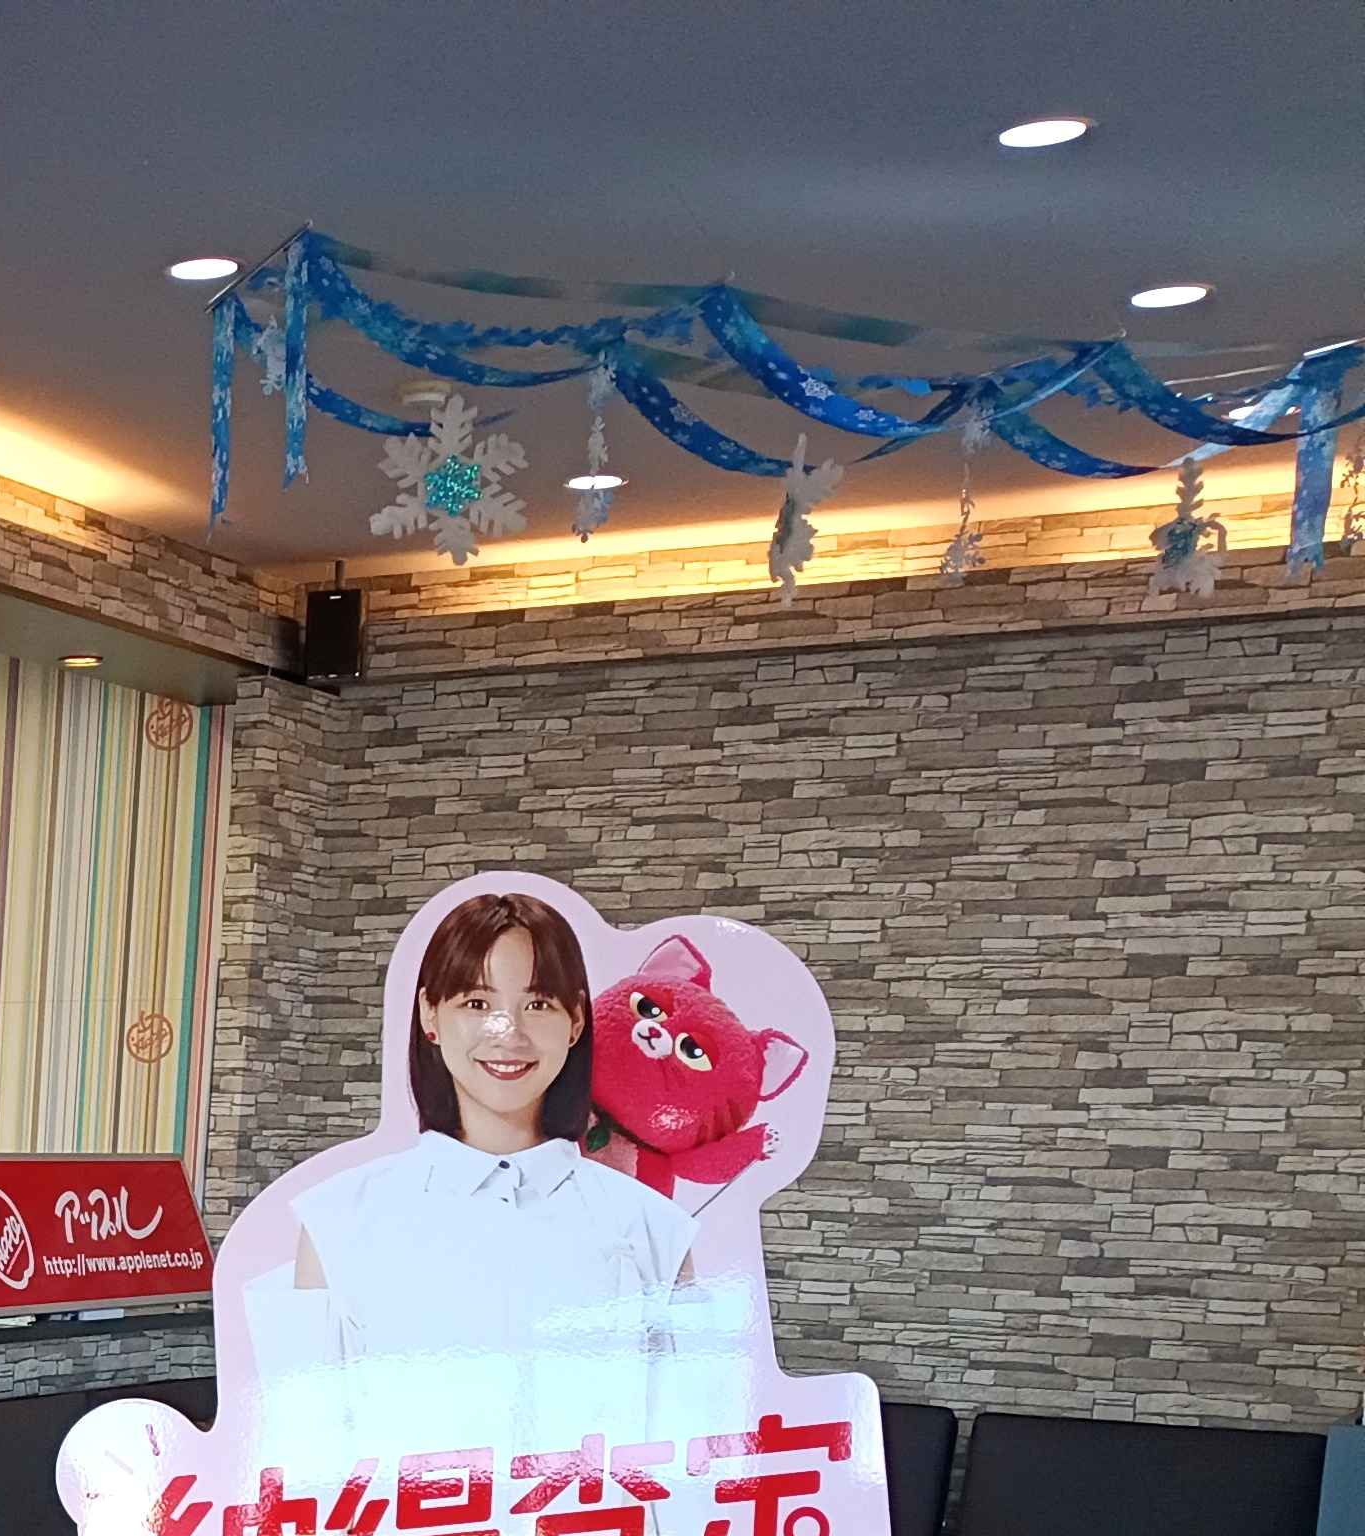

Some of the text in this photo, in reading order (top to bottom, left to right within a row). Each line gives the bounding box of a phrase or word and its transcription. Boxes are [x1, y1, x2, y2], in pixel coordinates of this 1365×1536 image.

[55, 1186, 163, 1244] アップル
[43, 1248, 204, 1278] http://www.applenet.co.jp
